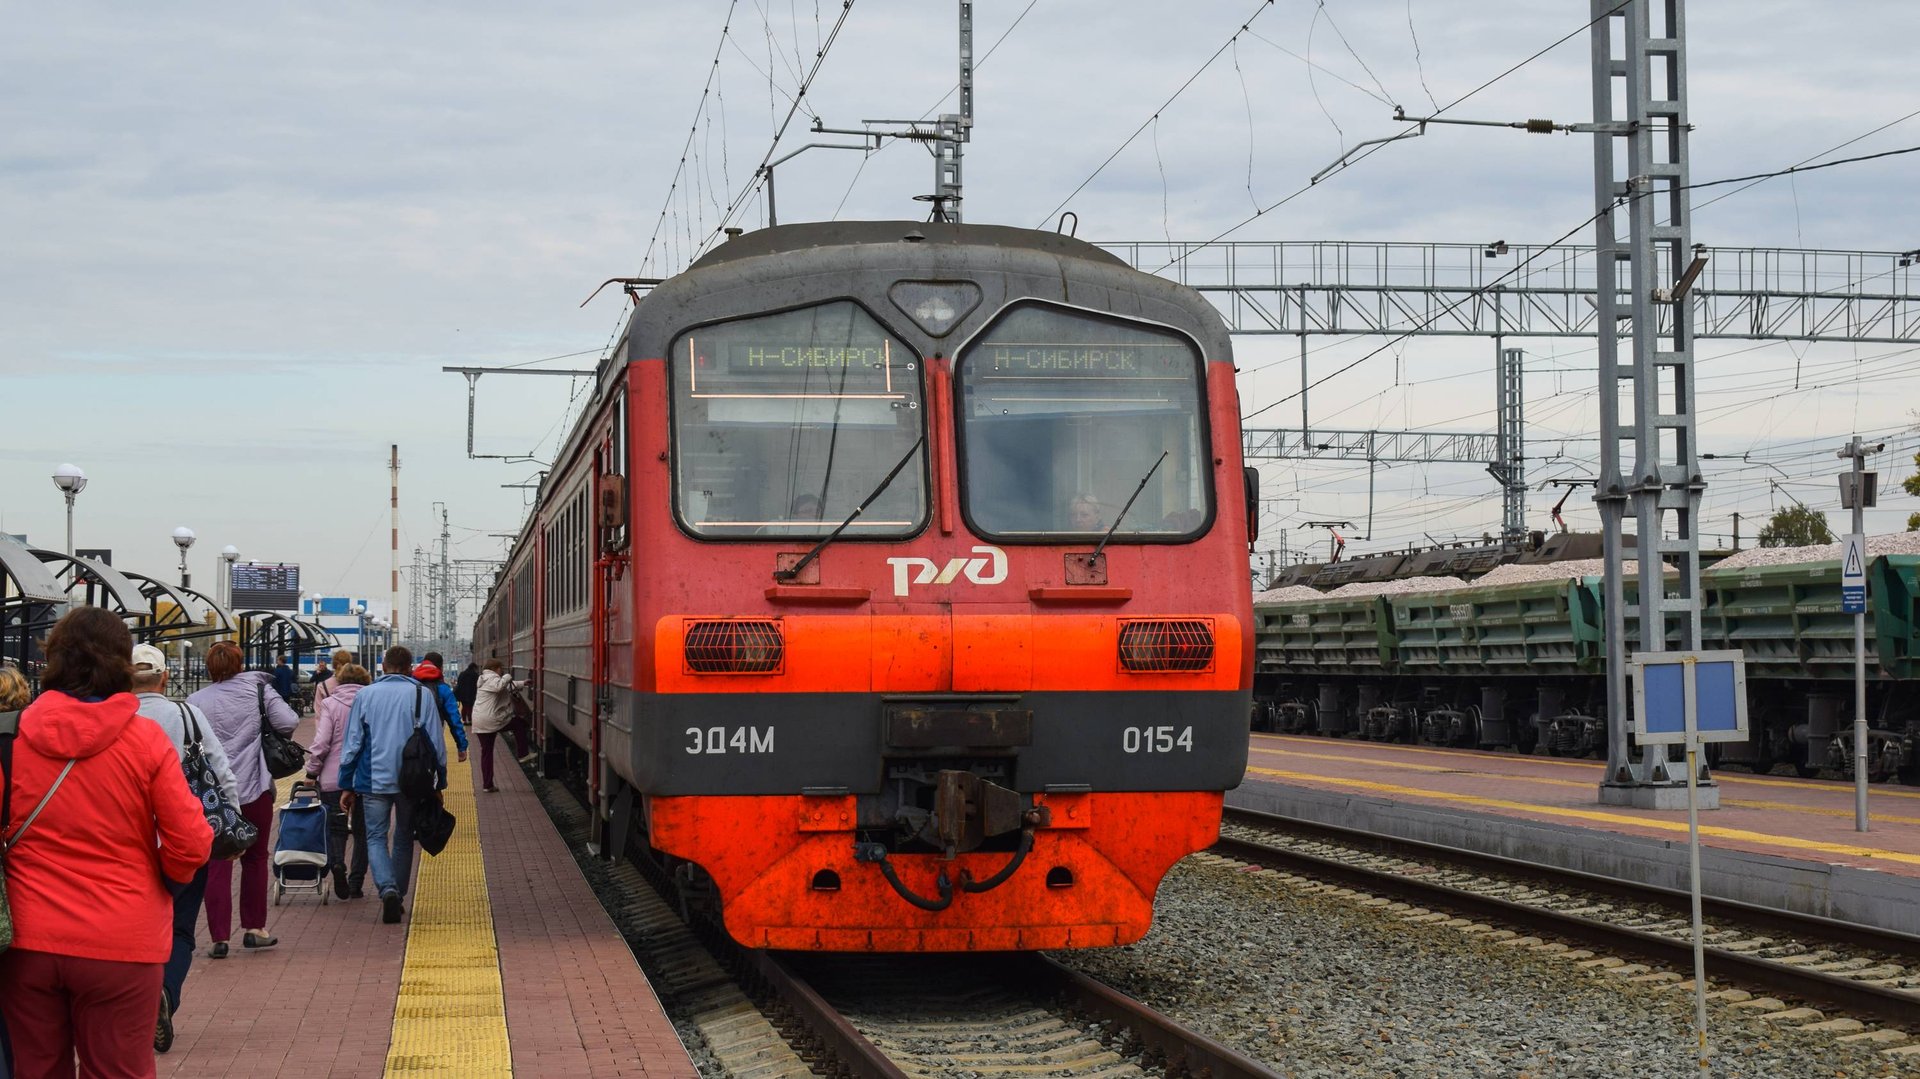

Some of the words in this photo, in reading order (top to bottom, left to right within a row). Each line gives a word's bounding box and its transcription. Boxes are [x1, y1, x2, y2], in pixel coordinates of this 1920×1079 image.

[994, 349, 1136, 370] Н-СИБИРСК
[685, 726, 775, 754] ЭД4М
[1123, 725, 1193, 753] 0154
